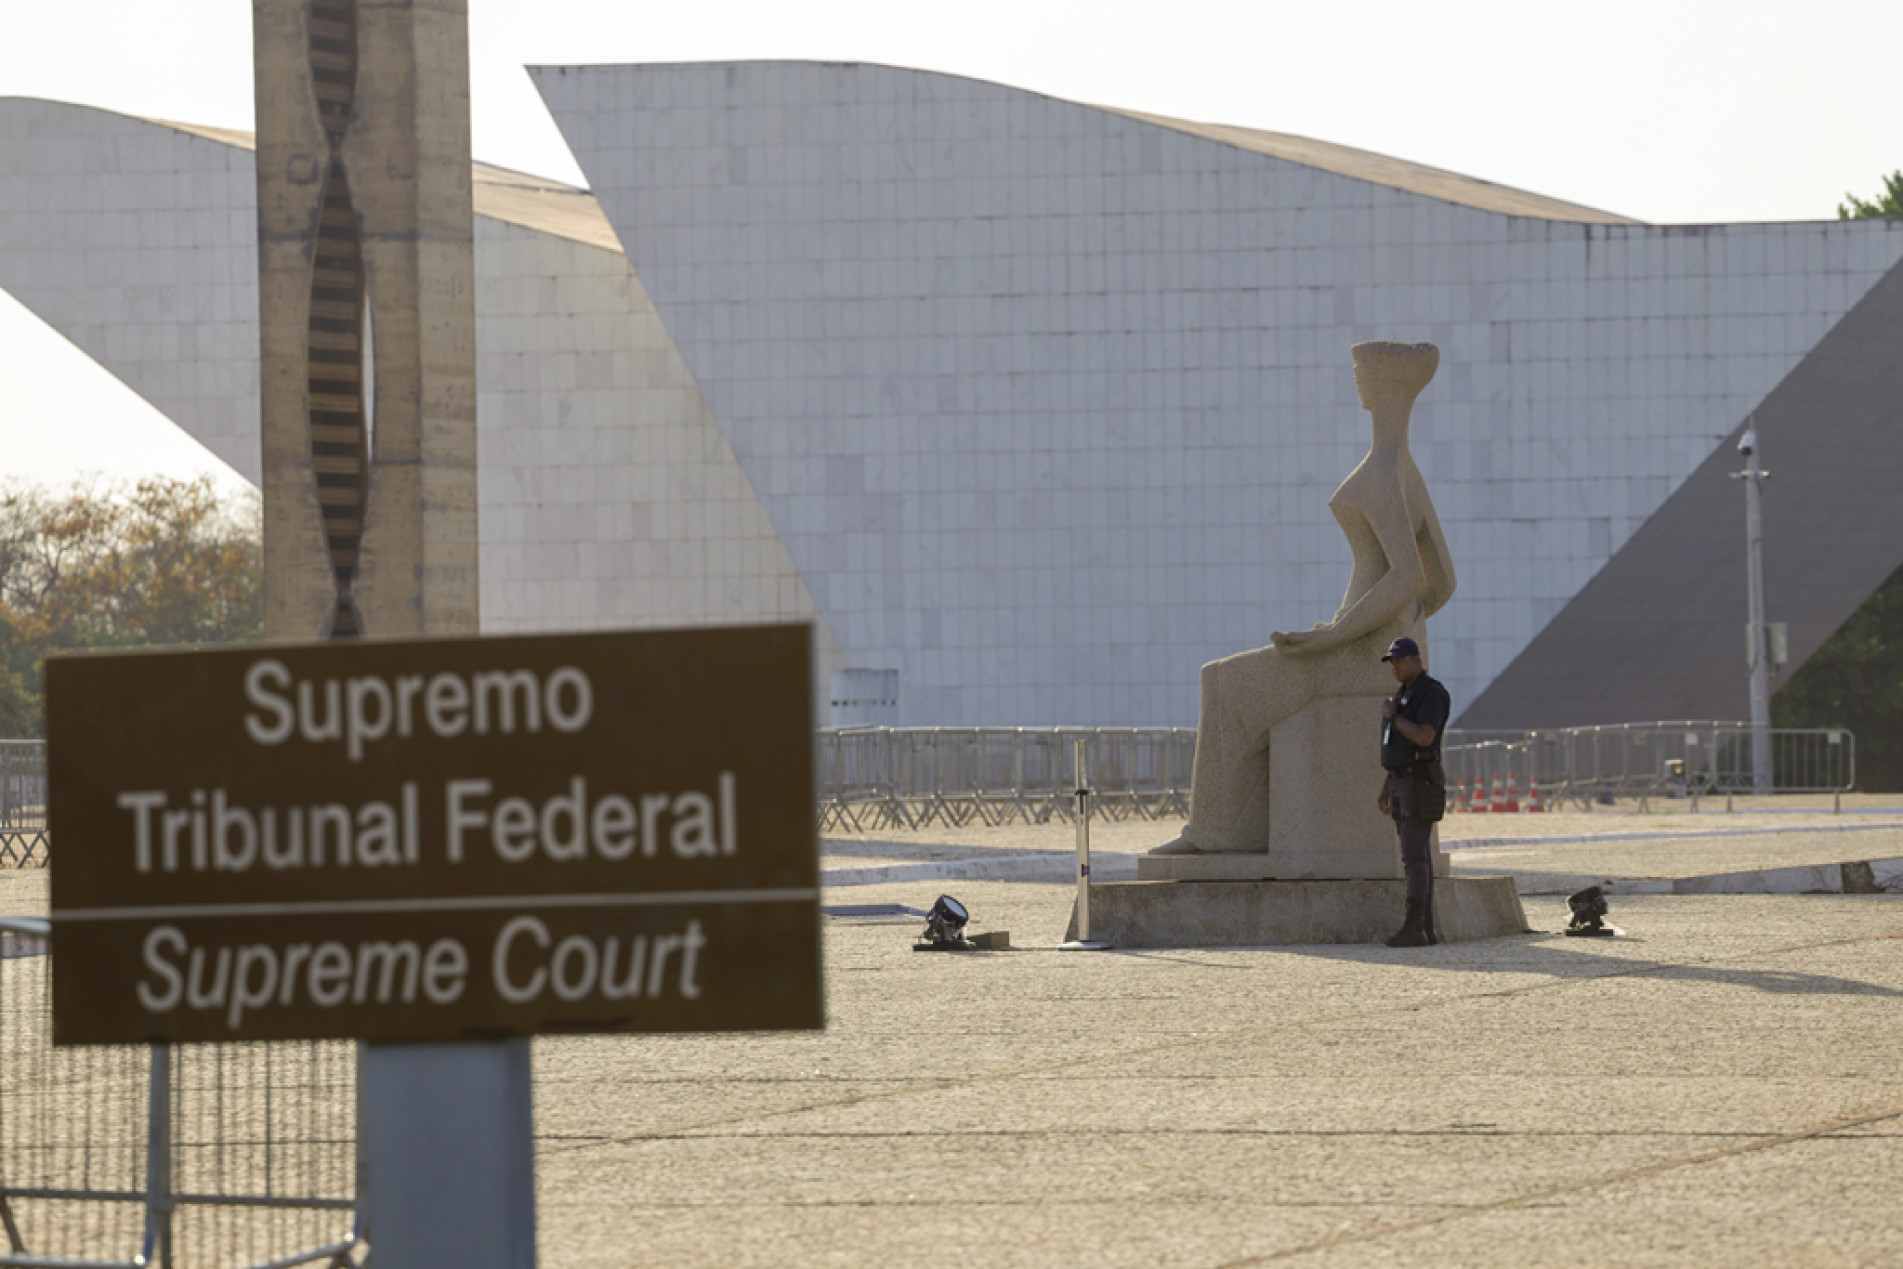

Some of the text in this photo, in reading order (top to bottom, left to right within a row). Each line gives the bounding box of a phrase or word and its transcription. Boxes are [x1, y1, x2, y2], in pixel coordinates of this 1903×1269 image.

[245, 660, 593, 761] Supremo
[118, 772, 737, 873] Tribunal Federal
[137, 915, 706, 1028] Supreme Court
